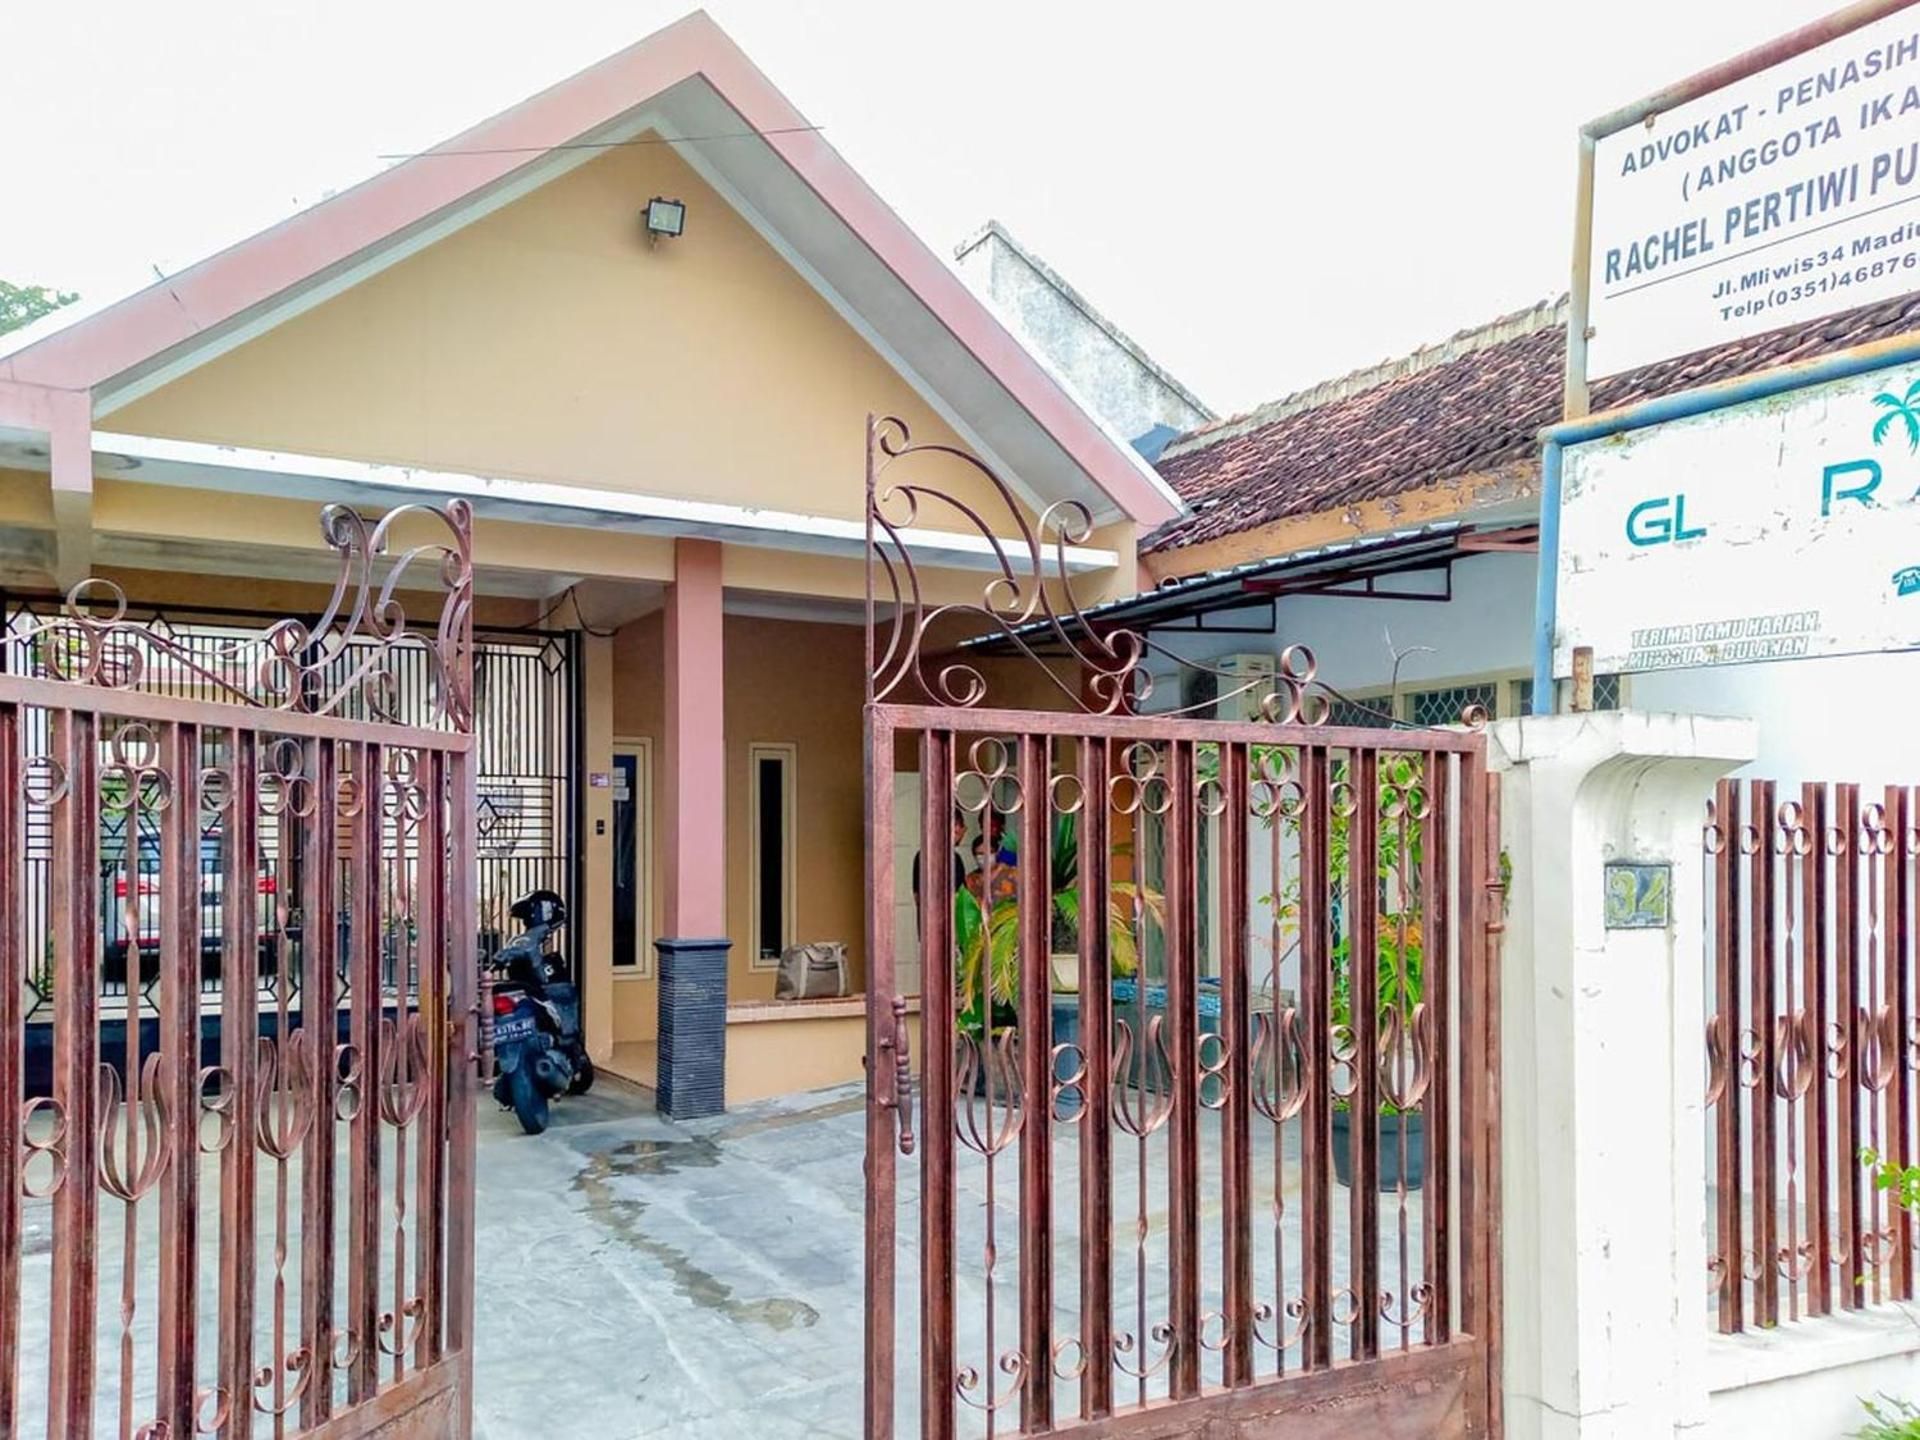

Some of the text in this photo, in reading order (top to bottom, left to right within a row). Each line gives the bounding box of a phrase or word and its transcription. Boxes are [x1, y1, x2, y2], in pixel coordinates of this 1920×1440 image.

[1621, 104, 1749, 177] ADVOKAT
[1777, 33, 1920, 115] PENASIH
[1604, 142, 1920, 285] RACHEL PERTIWI PU
[1631, 625, 1692, 648] TERIMA
[1693, 618, 1745, 643] TAMU
